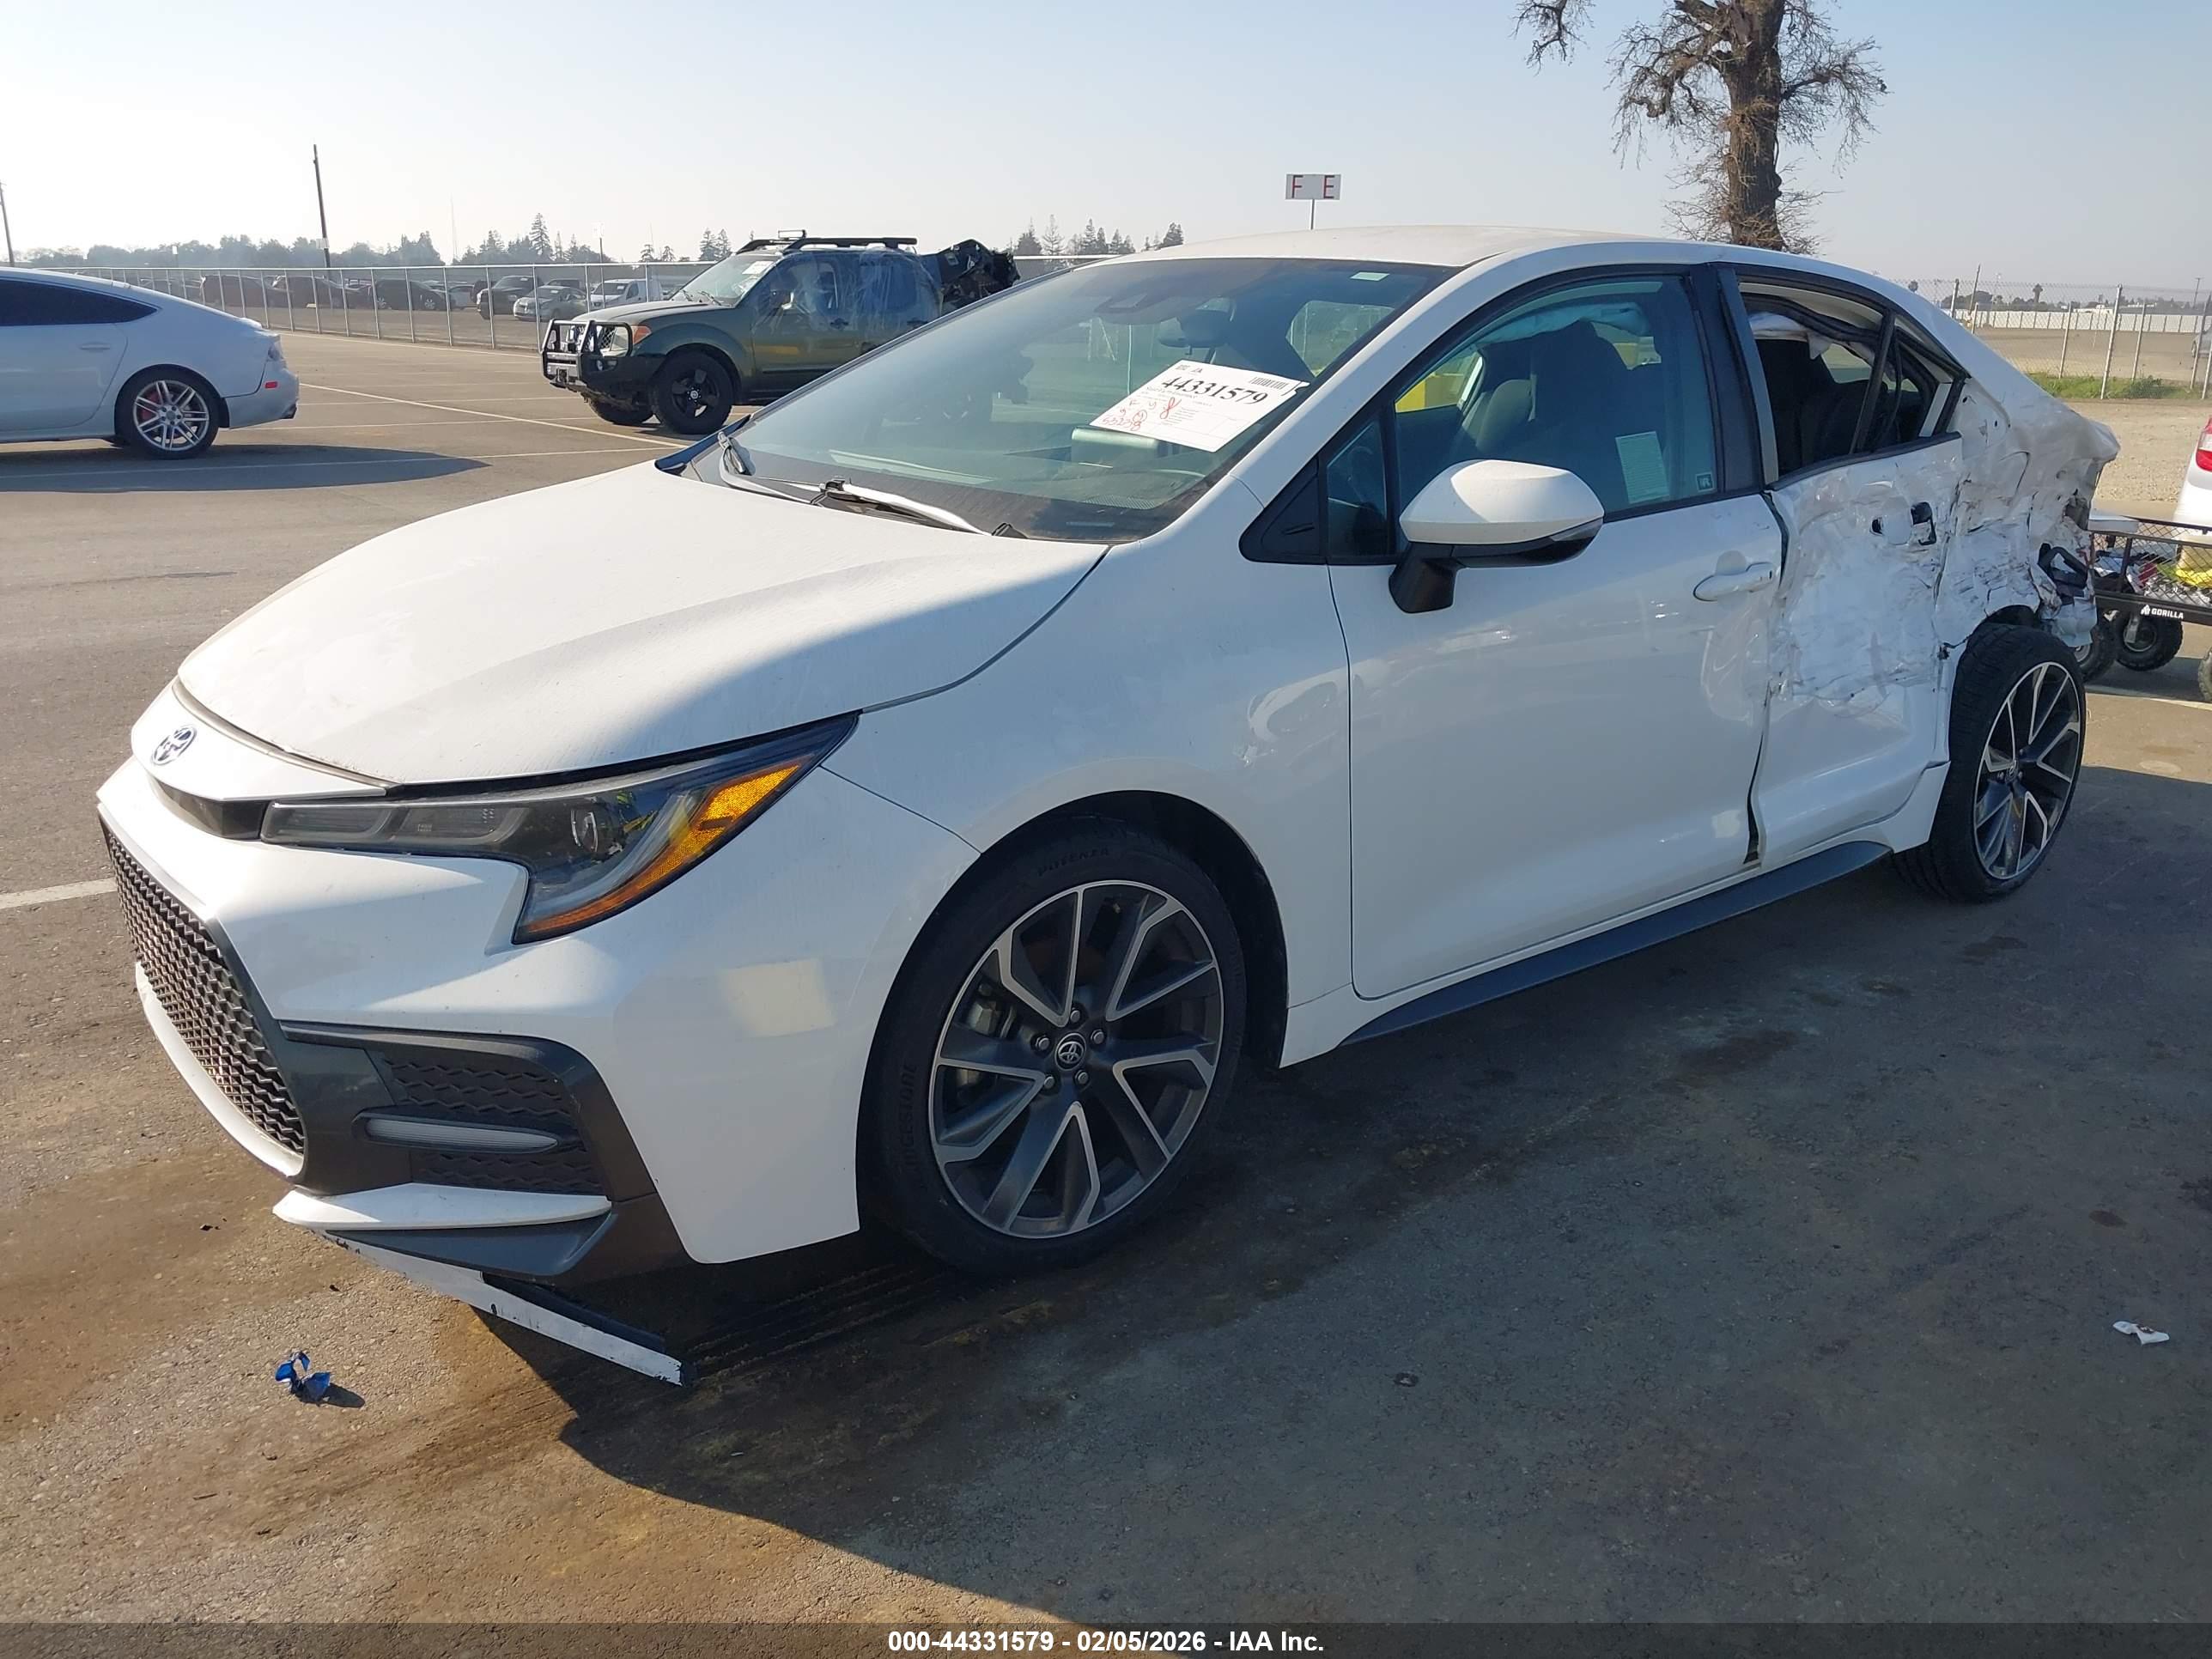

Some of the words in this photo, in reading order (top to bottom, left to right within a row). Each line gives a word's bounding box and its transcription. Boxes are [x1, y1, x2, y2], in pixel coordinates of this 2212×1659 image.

[1291, 174, 1304, 198] F
[1323, 174, 1335, 198] E
[1161, 376, 1268, 404] 44331579
[2151, 608, 2184, 619] GORILLA
